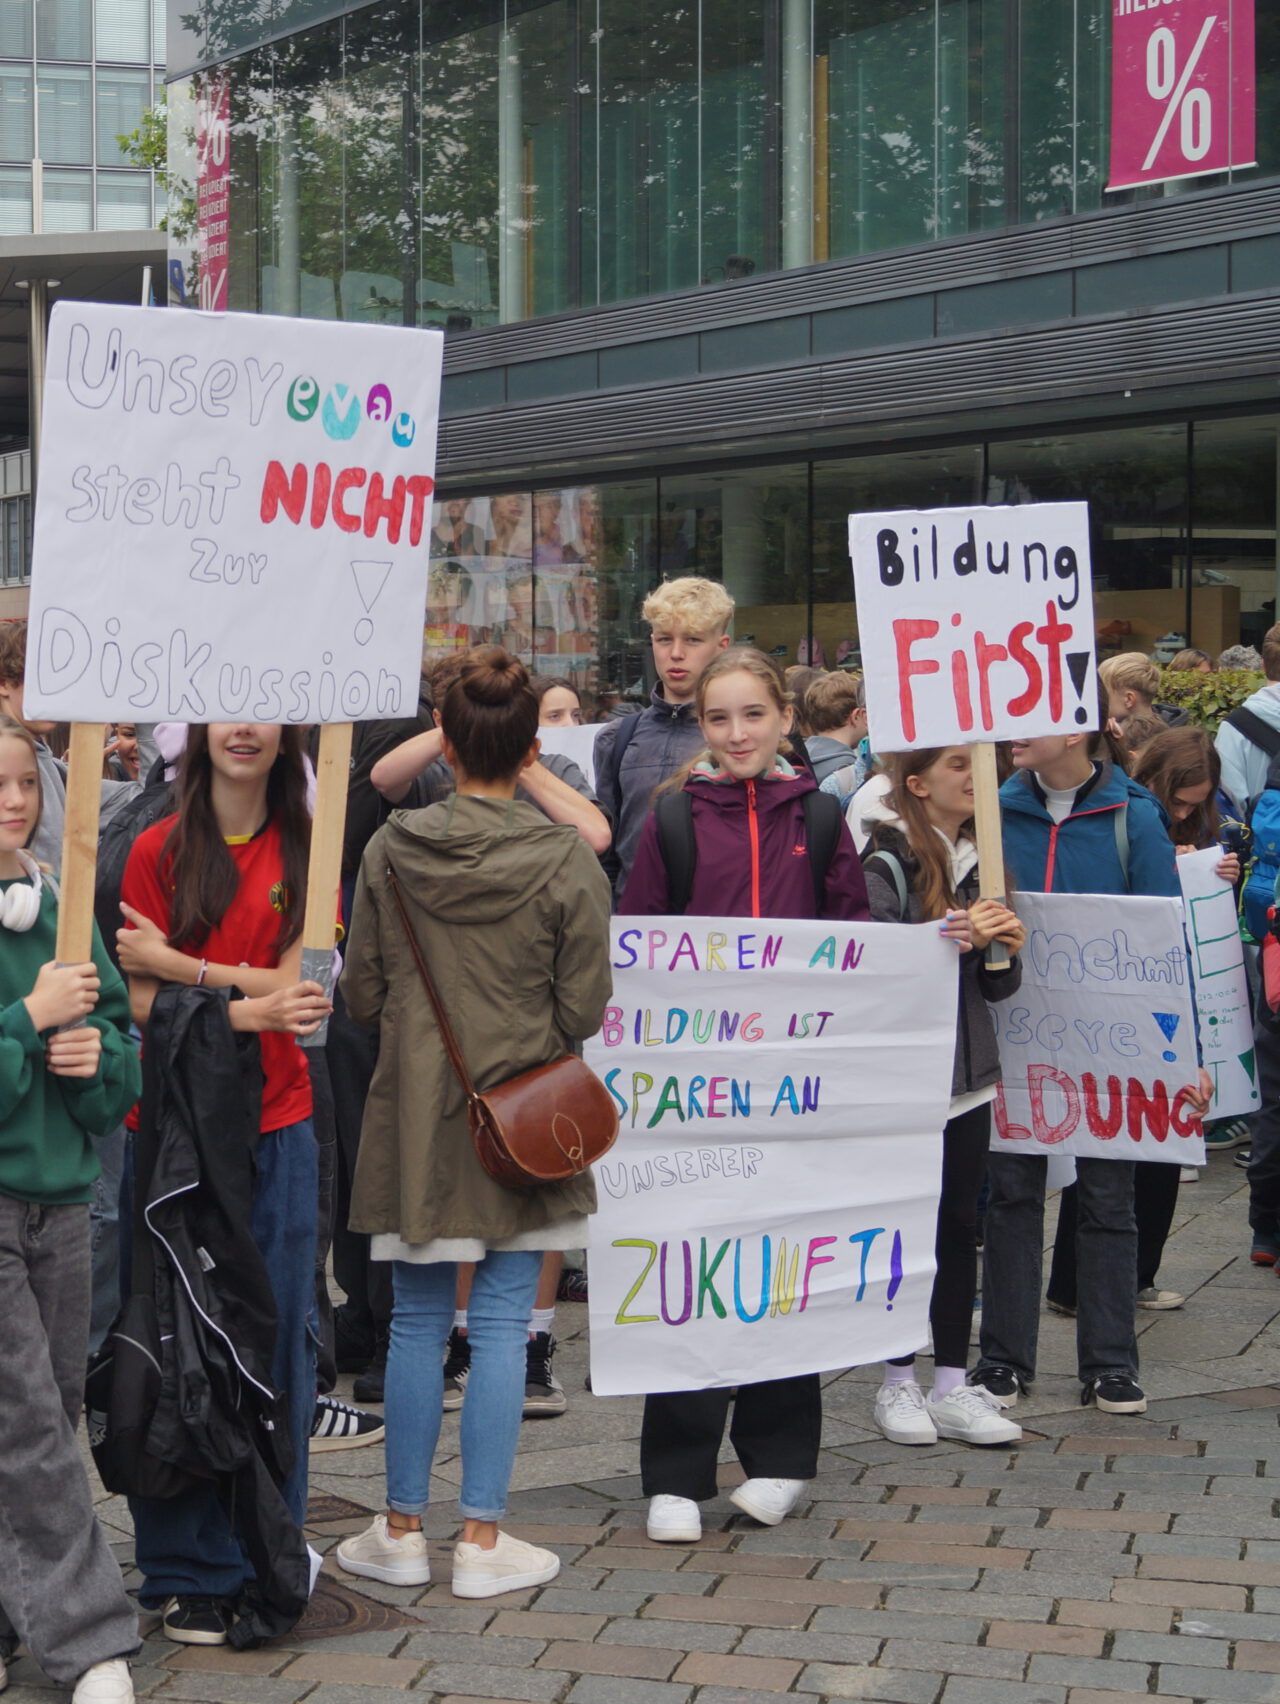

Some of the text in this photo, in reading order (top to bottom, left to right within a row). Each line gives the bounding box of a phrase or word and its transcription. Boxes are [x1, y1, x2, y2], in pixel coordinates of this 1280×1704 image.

[1141, 16, 1217, 170] %
[260, 460, 435, 547] NICHT
[877, 519, 1080, 611] Bildung
[892, 600, 1091, 743] First!
[613, 928, 865, 971] SPAREN AN
[603, 1006, 834, 1047] BILDUNG IST
[604, 1067, 821, 1129] SPAREN AN
[992, 1064, 1203, 1144] LDUNG
[601, 1146, 764, 1199] UNSERER
[611, 1227, 904, 1326] ZUKUNFT!
